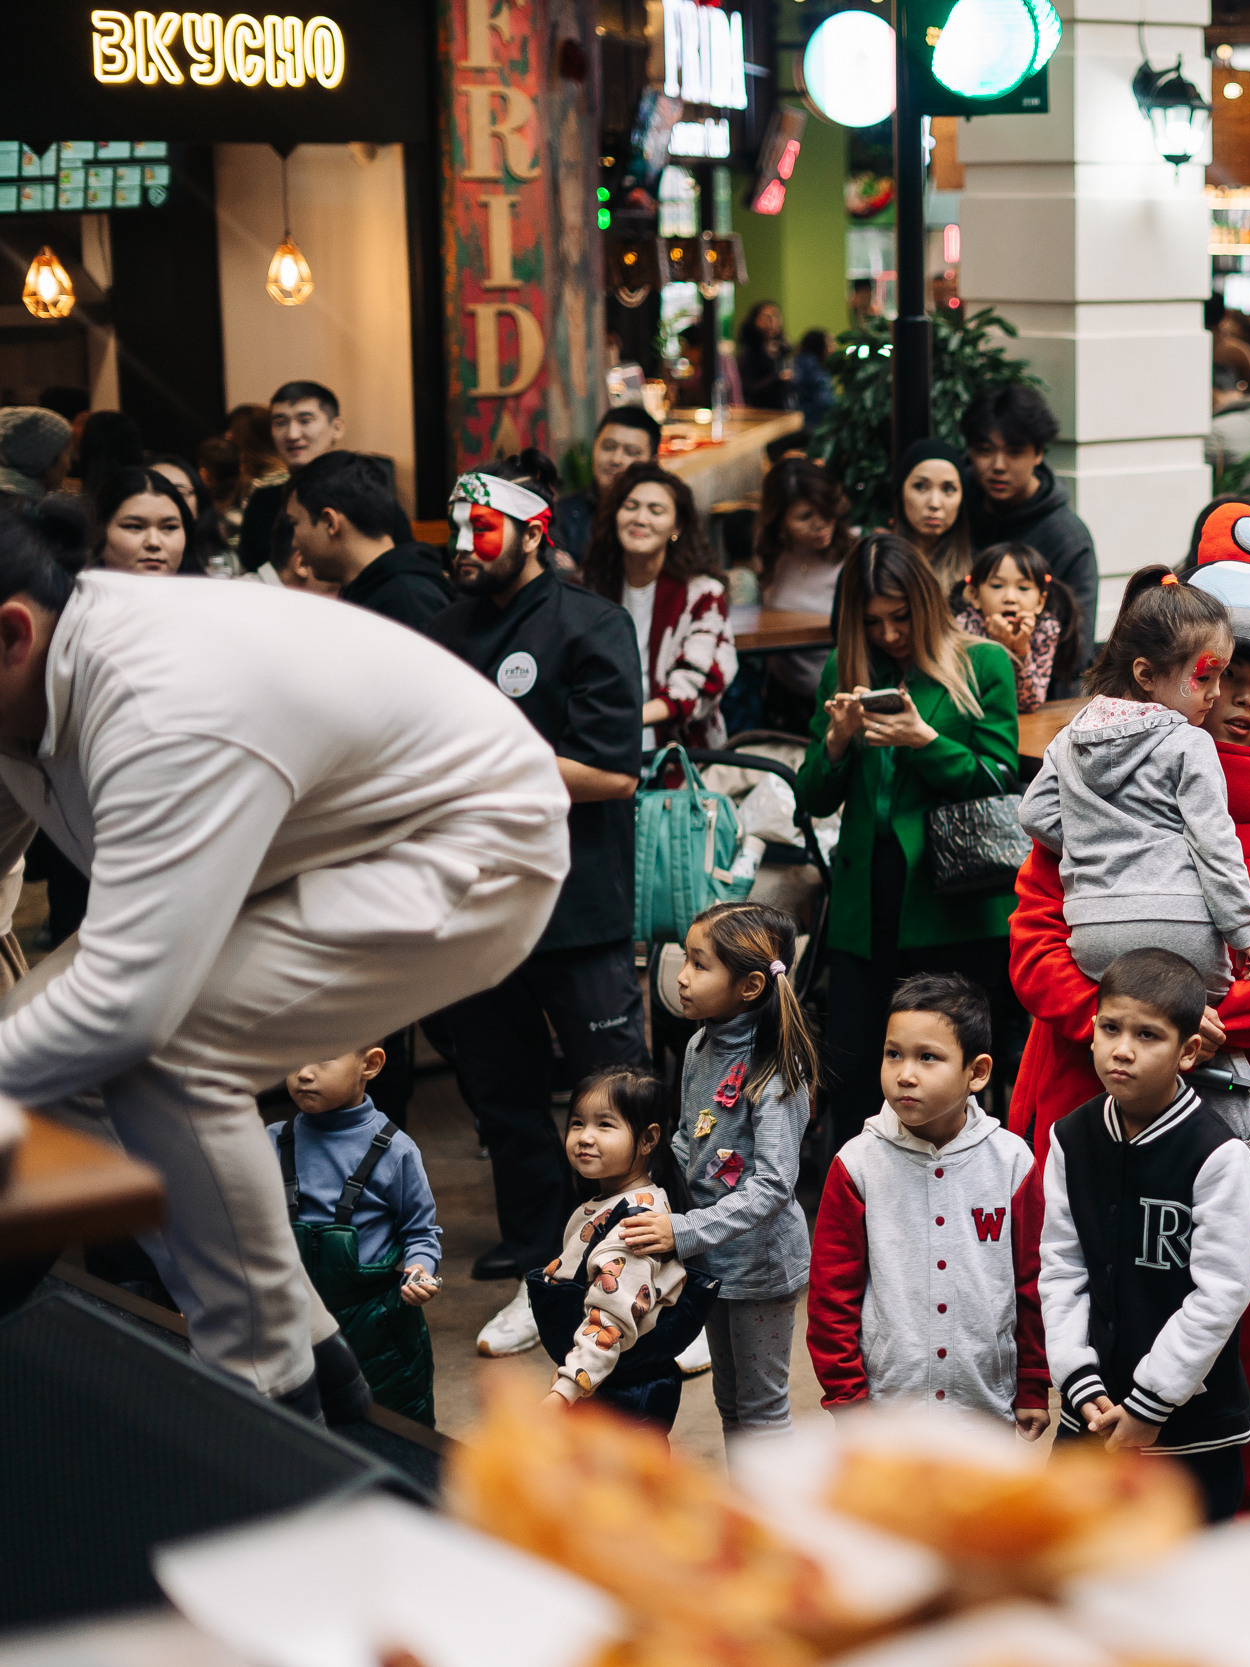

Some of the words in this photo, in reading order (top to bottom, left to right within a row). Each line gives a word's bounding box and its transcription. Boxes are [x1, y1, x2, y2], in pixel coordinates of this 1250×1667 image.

[91, 9, 345, 89] ВКУСНО
[971, 1206, 1006, 1242] W
[1135, 1197, 1192, 1270] R
